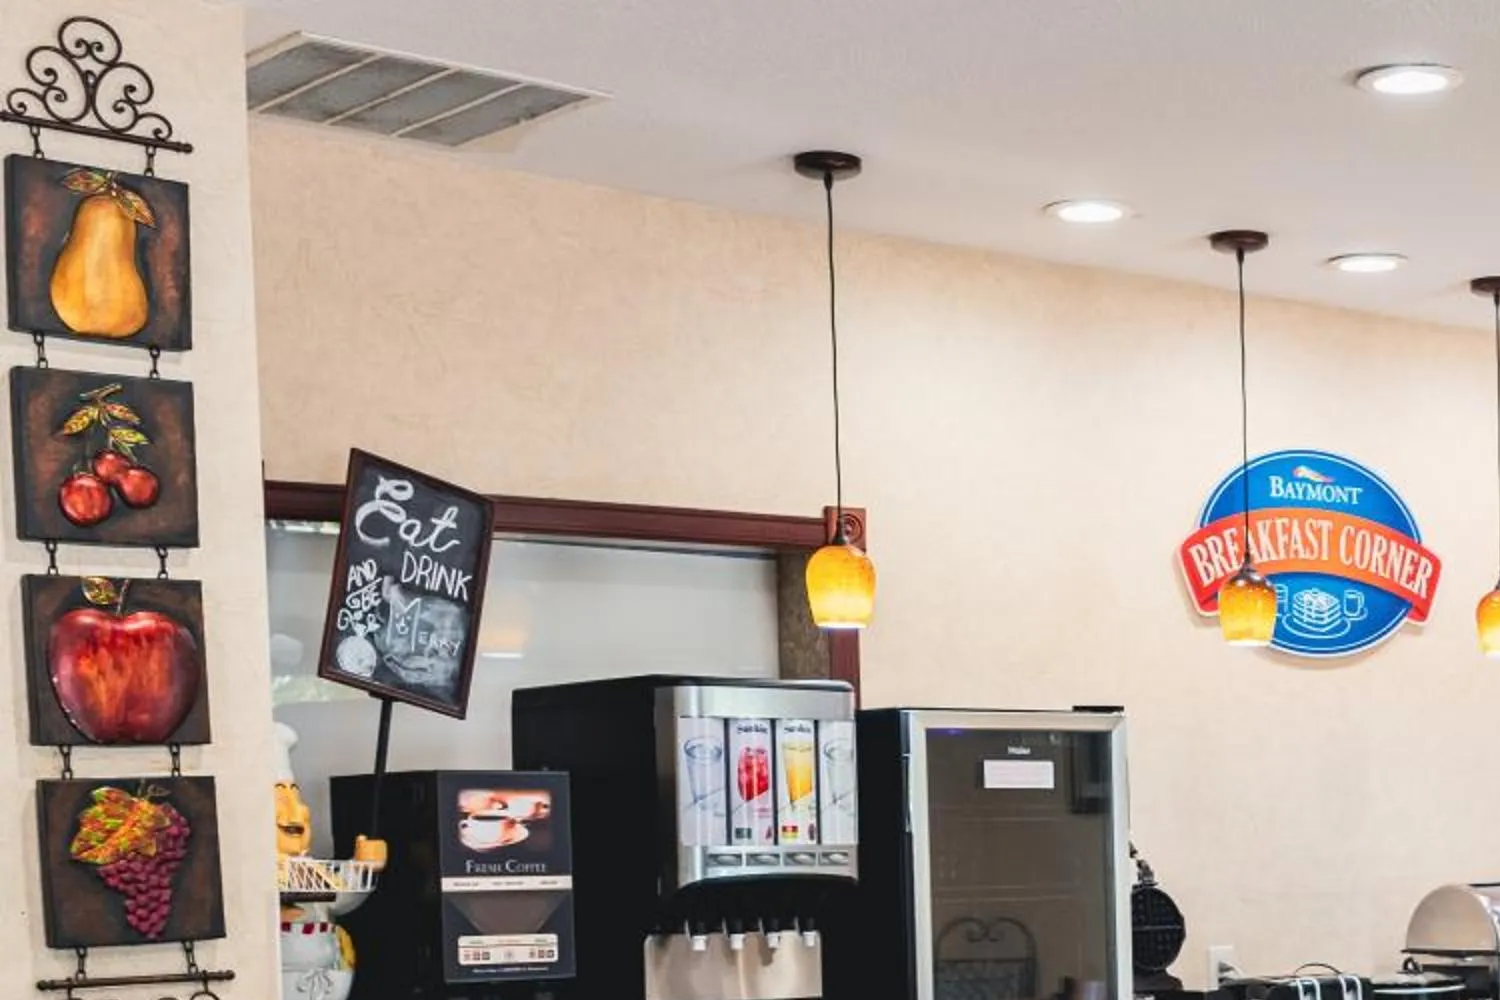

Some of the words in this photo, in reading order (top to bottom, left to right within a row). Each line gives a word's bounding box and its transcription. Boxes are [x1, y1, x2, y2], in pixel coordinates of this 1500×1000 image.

[355, 475, 460, 552] Eat
[1269, 475, 1363, 505] BAYMONT
[347, 559, 377, 592] AND
[401, 550, 472, 602] DRINK
[1188, 517, 1334, 588] BREAKFAST
[1339, 524, 1434, 599] CORNER
